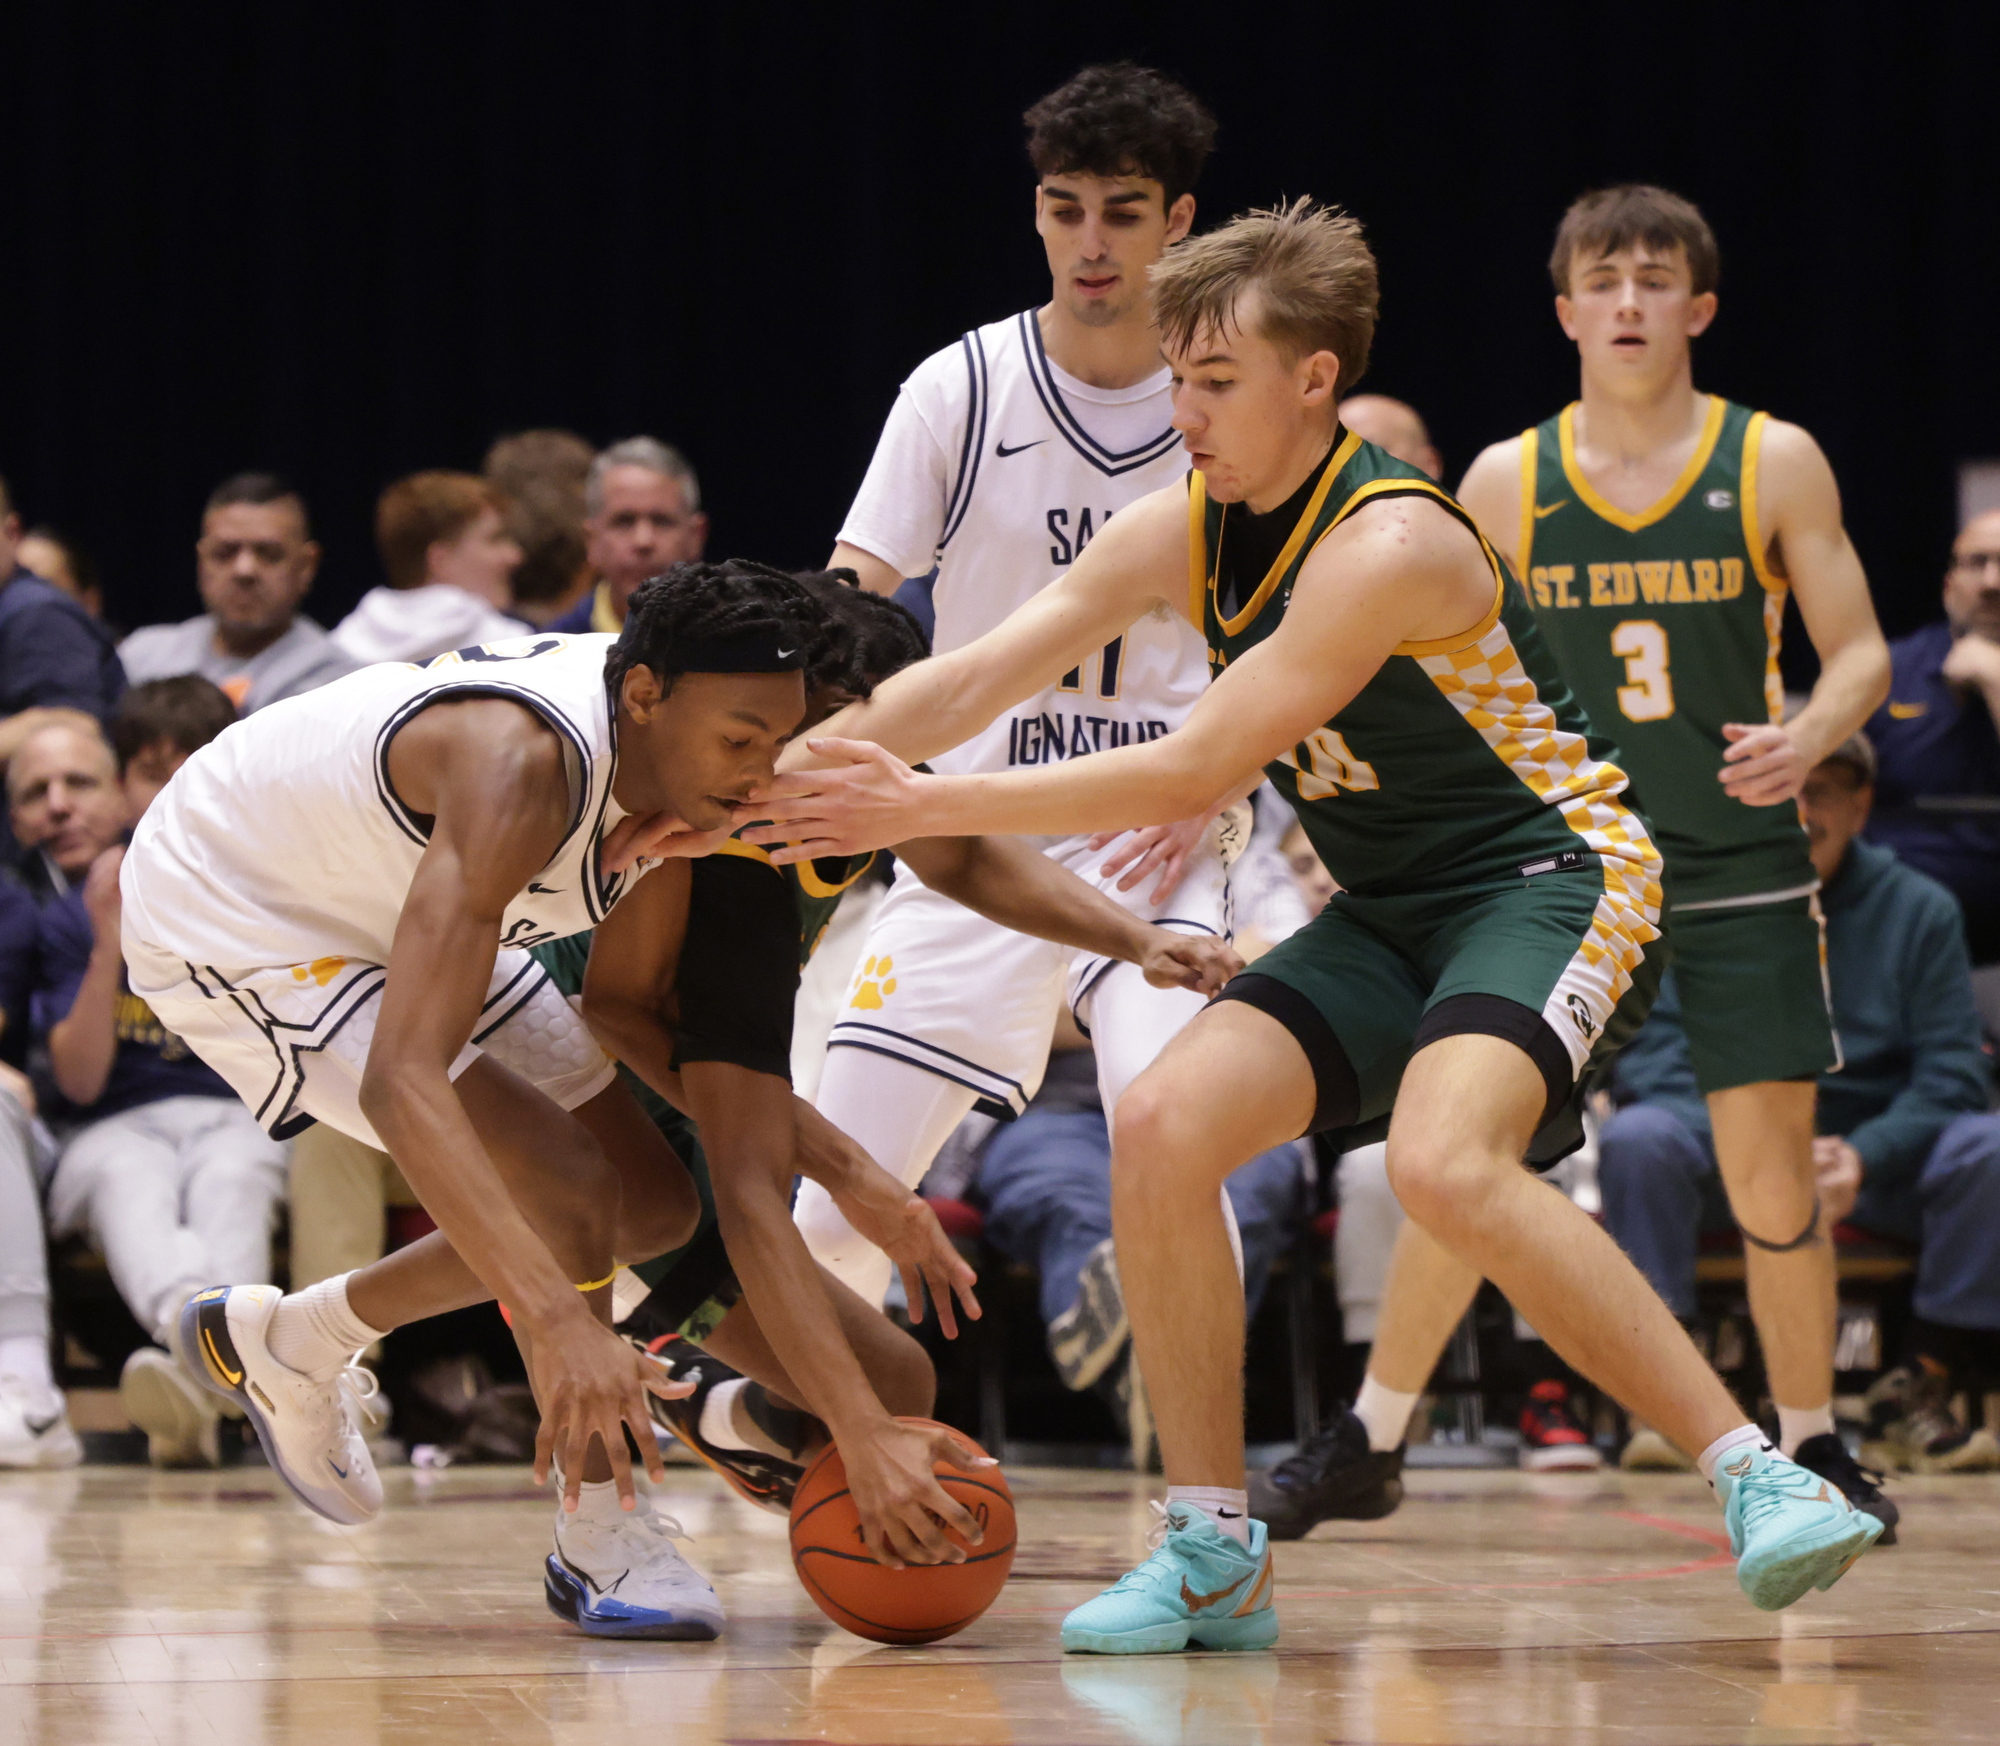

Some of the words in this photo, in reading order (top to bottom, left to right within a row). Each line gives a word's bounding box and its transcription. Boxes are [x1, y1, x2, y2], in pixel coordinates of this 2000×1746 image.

[1047, 507, 1112, 565] SA
[1531, 564, 1581, 608] ST.
[1588, 557, 1744, 606] EDWARD
[1610, 619, 1675, 723] 3
